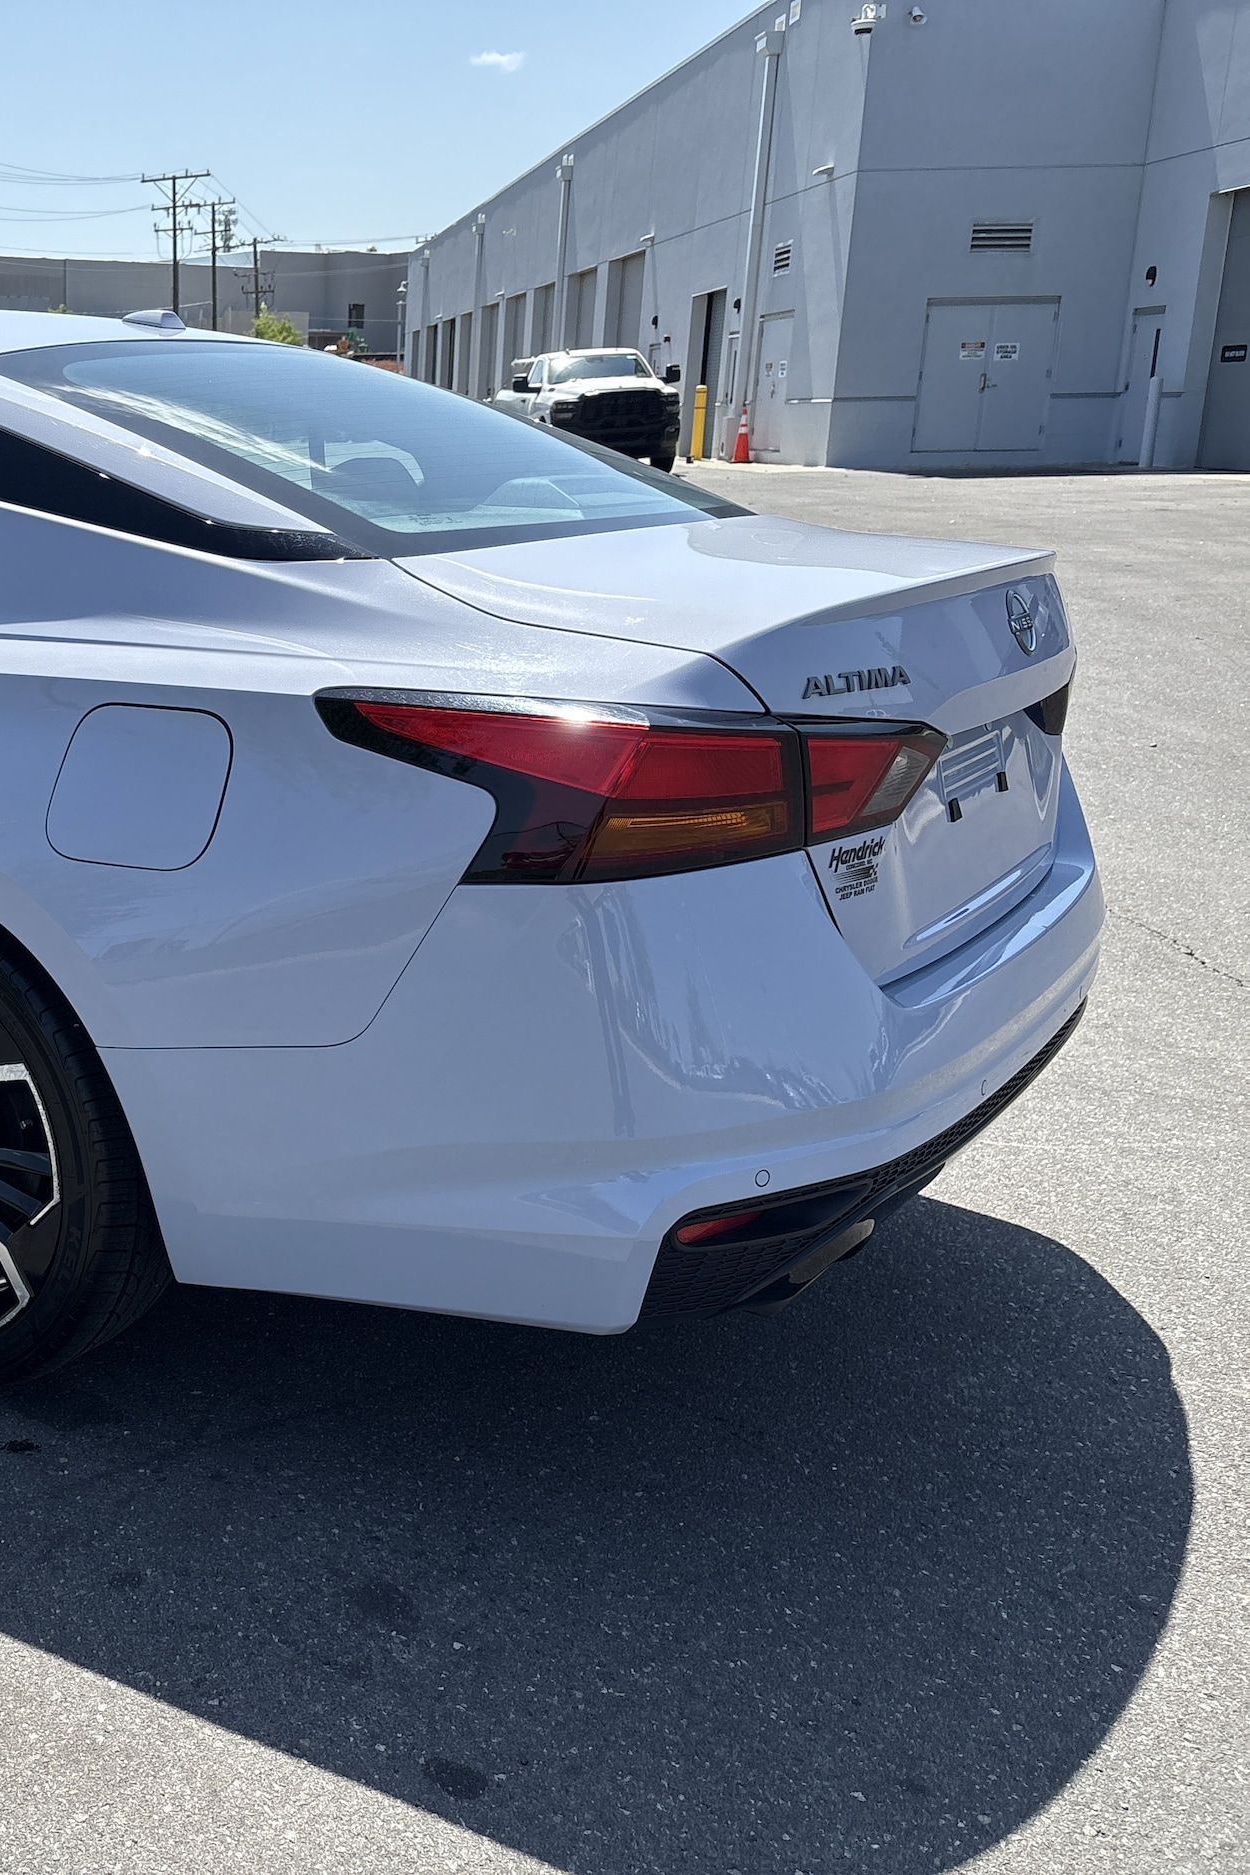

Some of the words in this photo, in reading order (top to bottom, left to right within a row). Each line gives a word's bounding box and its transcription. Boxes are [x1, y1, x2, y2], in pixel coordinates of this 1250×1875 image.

[801, 665, 912, 700] ALTIMA
[828, 835, 886, 873] Hendrick
[835, 881, 863, 894] CHRYSLER
[839, 891, 853, 901] JEEP
[853, 887, 865, 897] RAM
